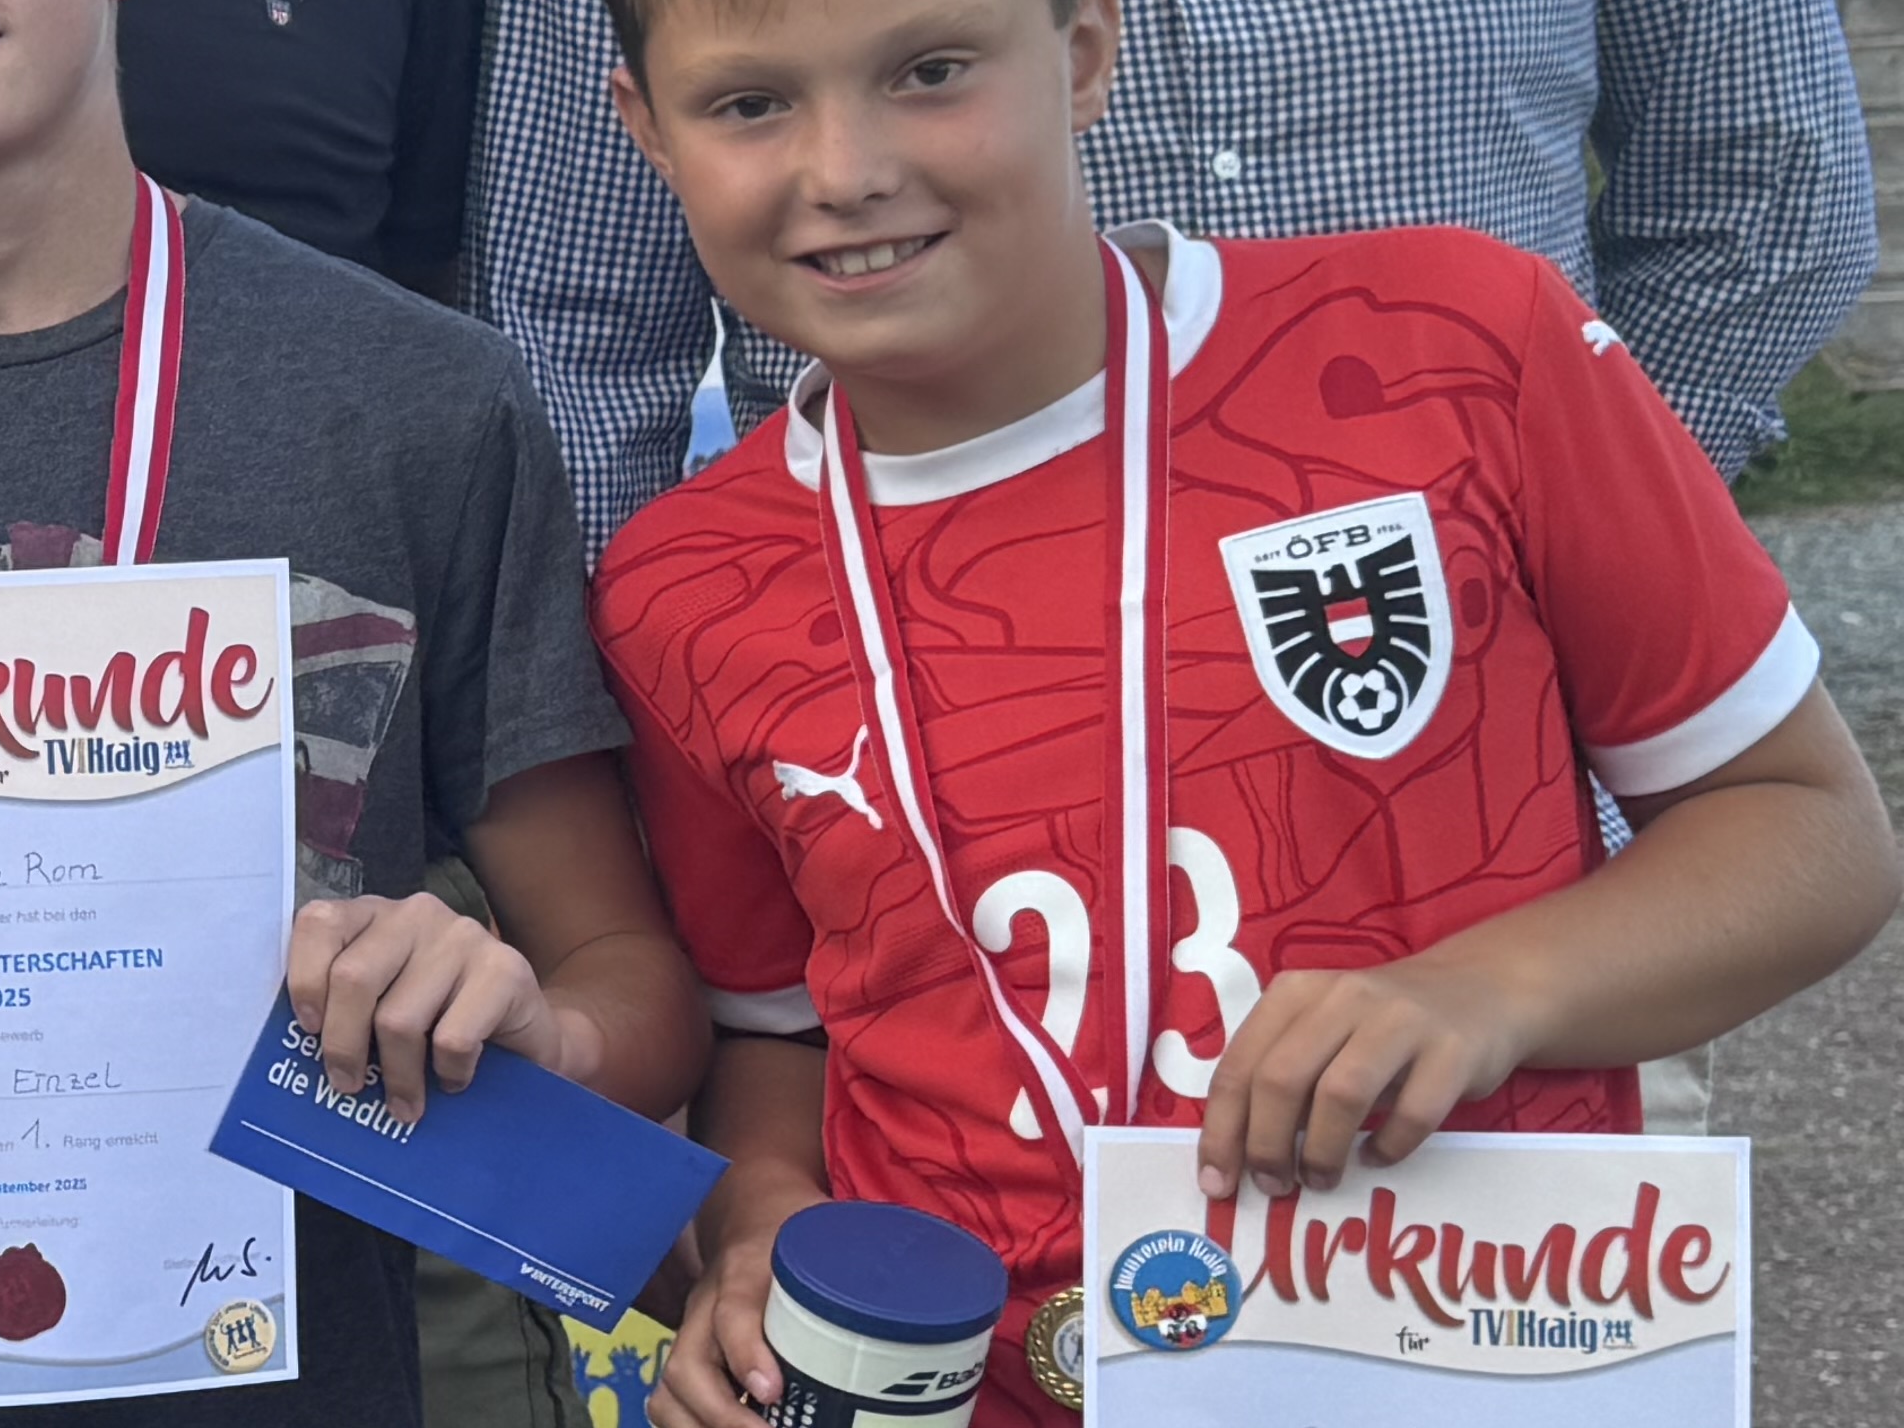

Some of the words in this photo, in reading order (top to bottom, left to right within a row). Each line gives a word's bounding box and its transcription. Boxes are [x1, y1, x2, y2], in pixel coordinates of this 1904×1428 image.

[1285, 524, 1372, 560] ÖFB
[24, 852, 104, 885] Rom
[973, 828, 1263, 1140] 23
[268, 1058, 309, 1095] die
[21, 1118, 50, 1149] 1.
[1205, 1182, 1730, 1328] Urkunde
